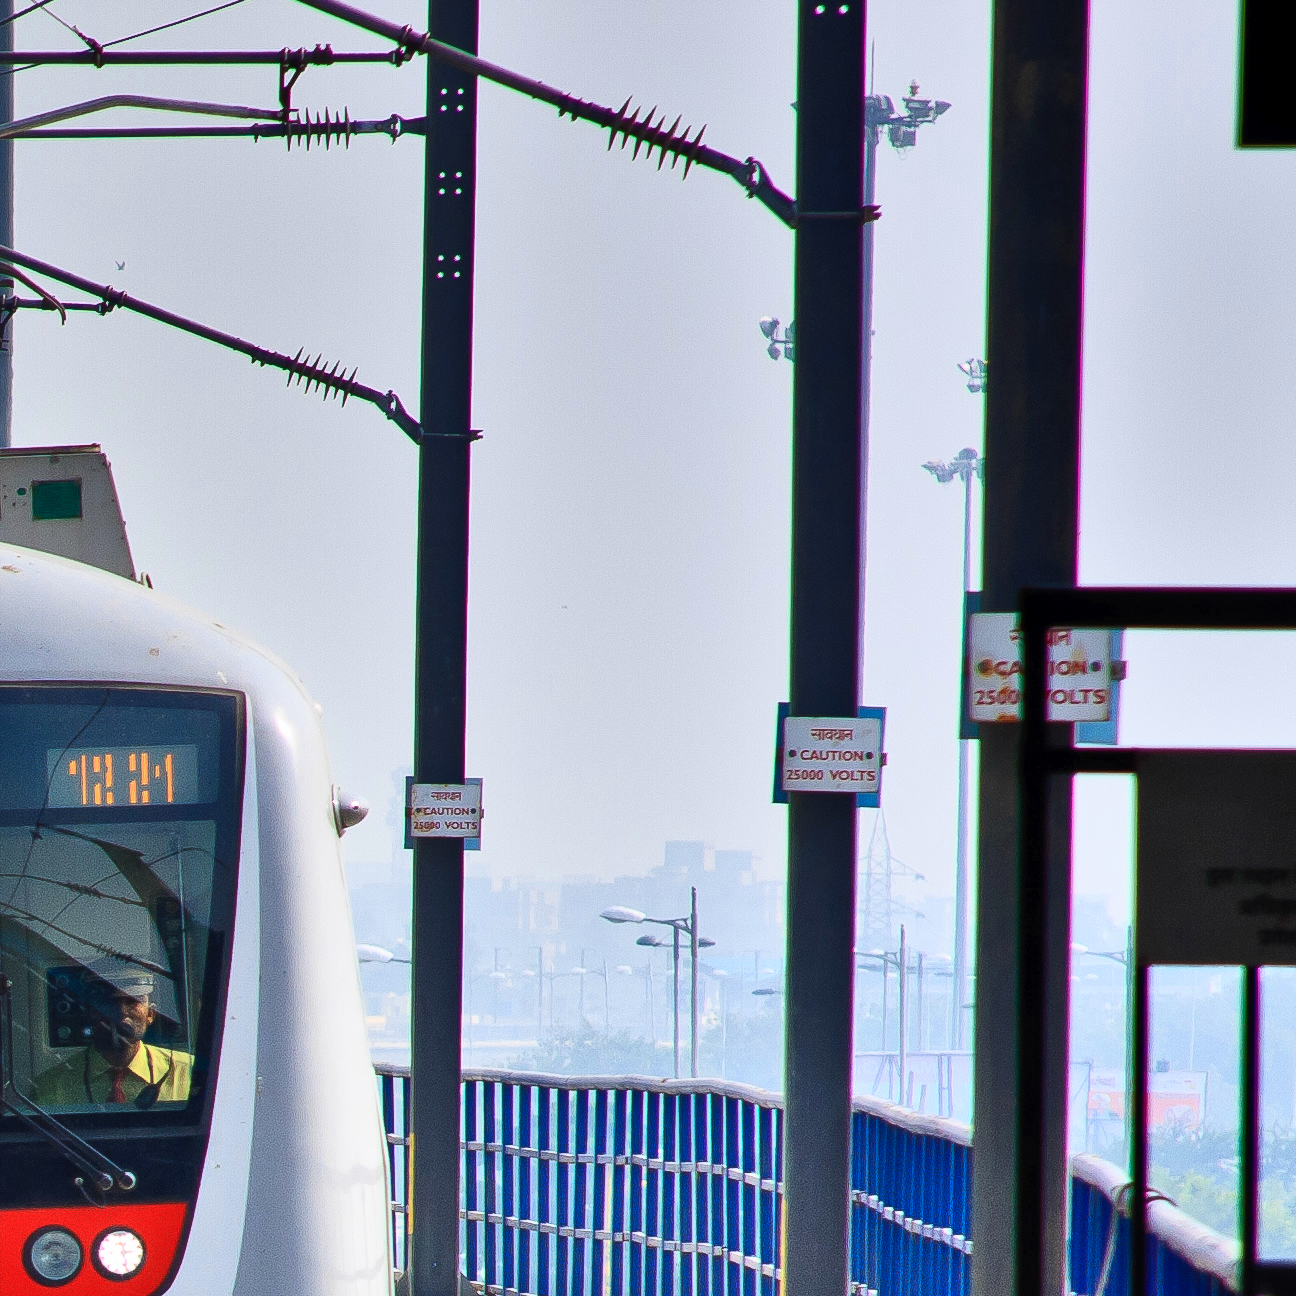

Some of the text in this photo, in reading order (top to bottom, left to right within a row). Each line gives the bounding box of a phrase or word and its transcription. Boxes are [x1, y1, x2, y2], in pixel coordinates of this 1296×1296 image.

[994, 660, 1088, 676] CAION
[974, 689, 1021, 706] 2500
[800, 749, 865, 762] CAUTION
[786, 769, 876, 782] 25000 VOLTS
[423, 807, 470, 816] CAUTION
[444, 821, 478, 830] VOLTS
